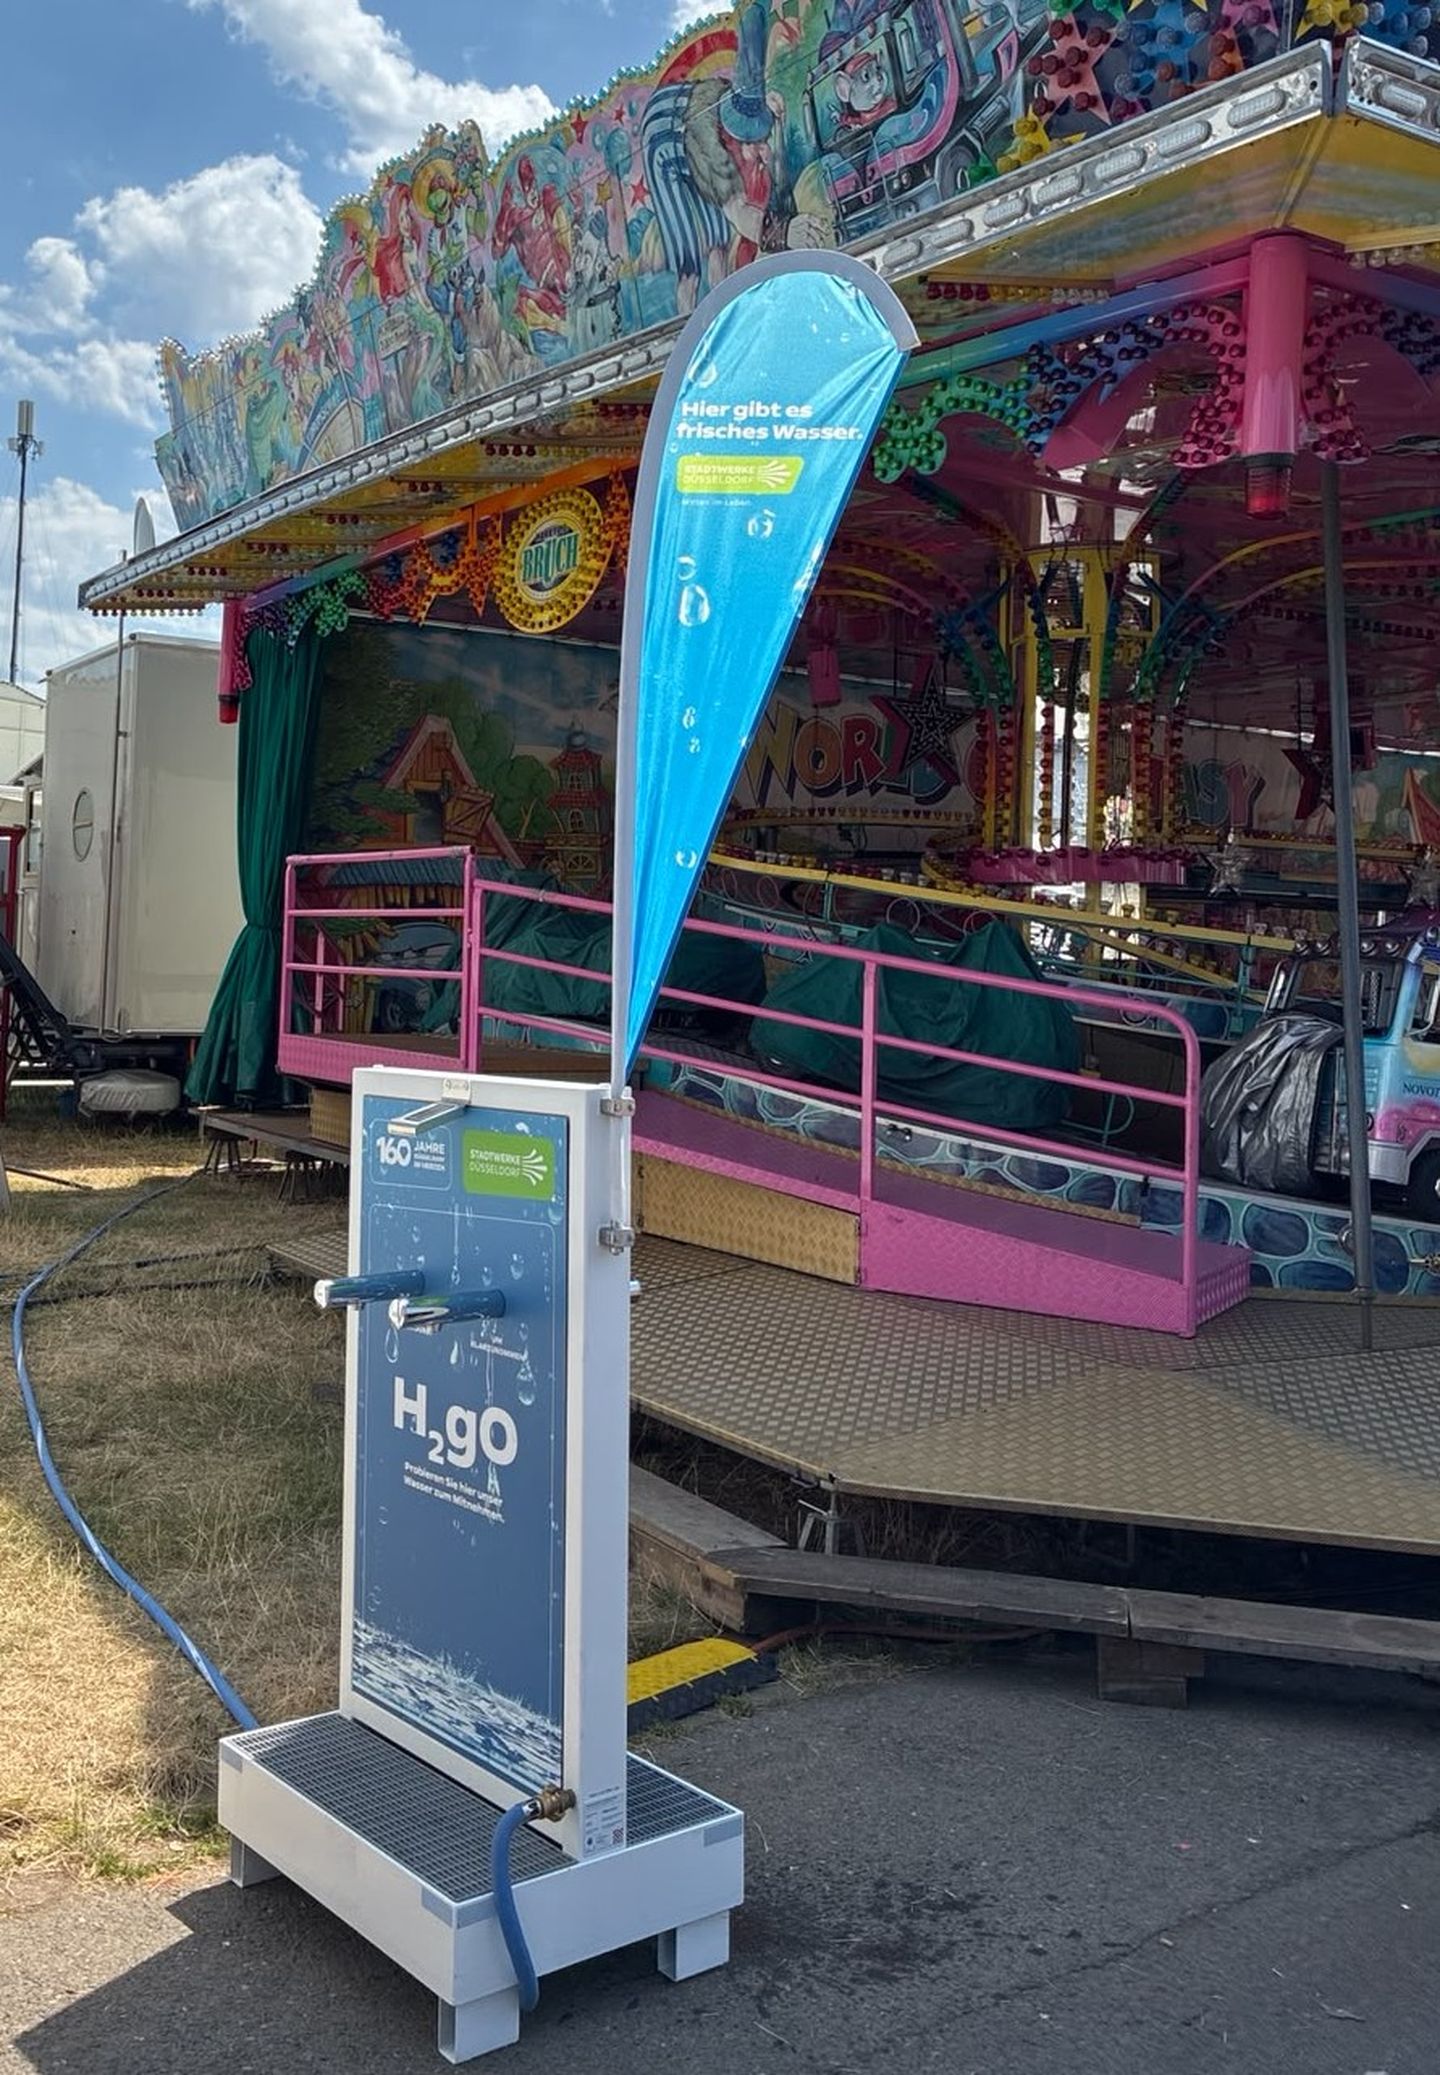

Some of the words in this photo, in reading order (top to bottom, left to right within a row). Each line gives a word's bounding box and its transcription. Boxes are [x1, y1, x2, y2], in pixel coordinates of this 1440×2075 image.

[681, 401, 731, 418] Hier
[733, 401, 782, 421] gibt
[786, 404, 813, 418] es
[676, 421, 769, 440] frisches
[773, 424, 864, 441] Wasser.
[522, 532, 579, 584] BRUCH
[376, 1136, 412, 1167] 160
[414, 1140, 446, 1155] JAHRE
[469, 1148, 521, 1166] STADTWERKE
[403, 1474, 434, 1496] Wasser
[434, 1487, 452, 1502] zum
[404, 1460, 446, 1484] Probieren
[446, 1476, 459, 1491] Sie
[459, 1481, 476, 1496] hier
